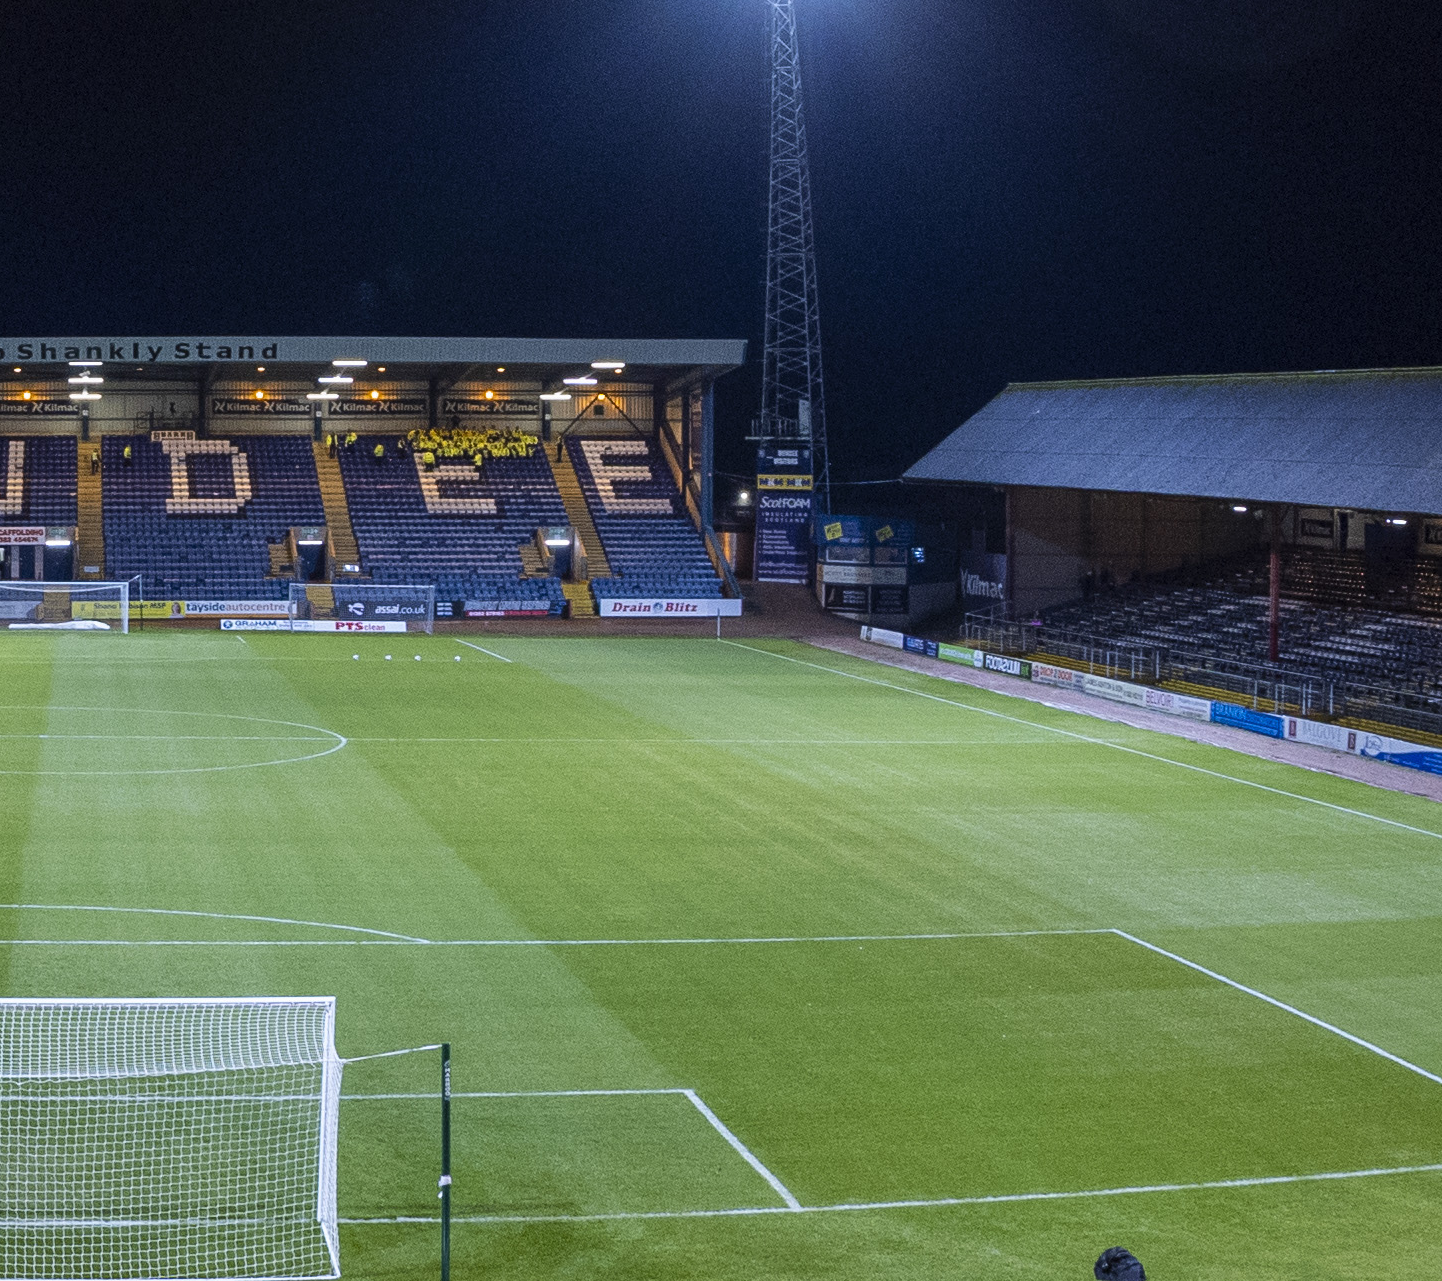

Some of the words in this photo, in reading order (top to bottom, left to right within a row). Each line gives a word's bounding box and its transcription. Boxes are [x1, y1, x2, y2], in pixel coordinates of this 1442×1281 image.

[18, 341, 163, 363] Shankly
[174, 342, 279, 361] Stand
[44, 402, 78, 413] Kilmac
[226, 401, 260, 413] Kilmac
[275, 401, 310, 413] Kilmac
[343, 401, 377, 412] Kilmac
[391, 402, 424, 413] Kilmac
[456, 402, 489, 413] Kilmac
[506, 403, 539, 413] Kilmac
[759, 496, 811, 509] ScotFOAM
[611, 602, 651, 613] Drain
[663, 602, 698, 613] Blitz
[335, 622, 364, 631] PTS
